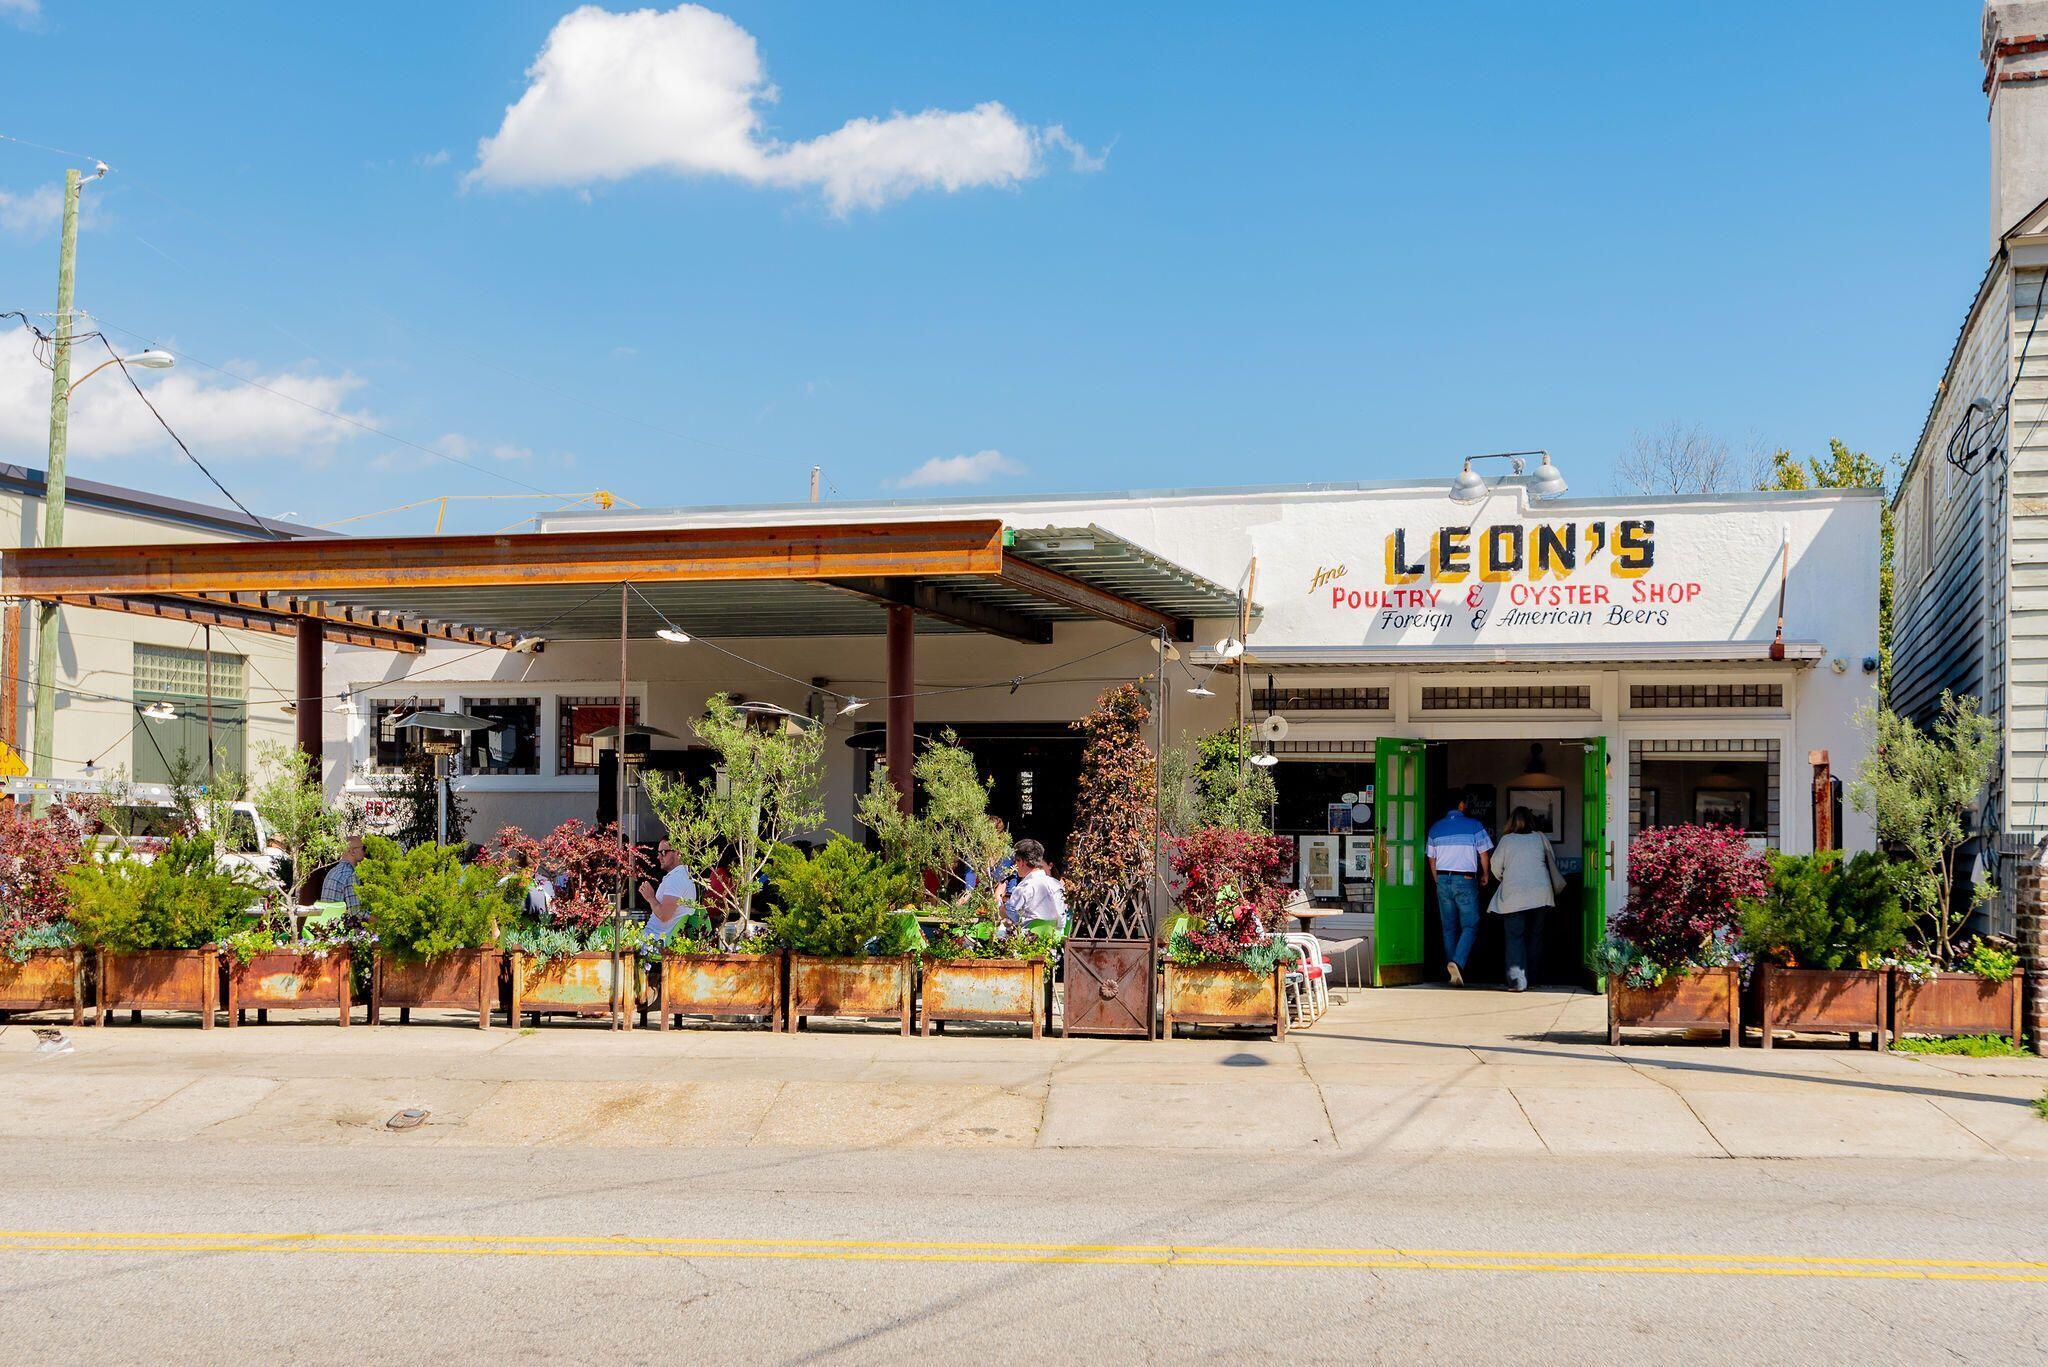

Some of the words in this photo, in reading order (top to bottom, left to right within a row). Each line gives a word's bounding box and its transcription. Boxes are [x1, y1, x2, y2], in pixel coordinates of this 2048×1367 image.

[1384, 519, 1655, 585] LEON'S
[1332, 586, 1442, 609] POULTRY
[1466, 584, 1484, 611] &
[1510, 583, 1610, 606] OYSTER
[1632, 579, 1702, 604] SHOP
[1381, 608, 1453, 632] Foreign
[1470, 609, 1488, 632] &
[1496, 606, 1592, 627] American
[1603, 604, 1670, 626] Beers
